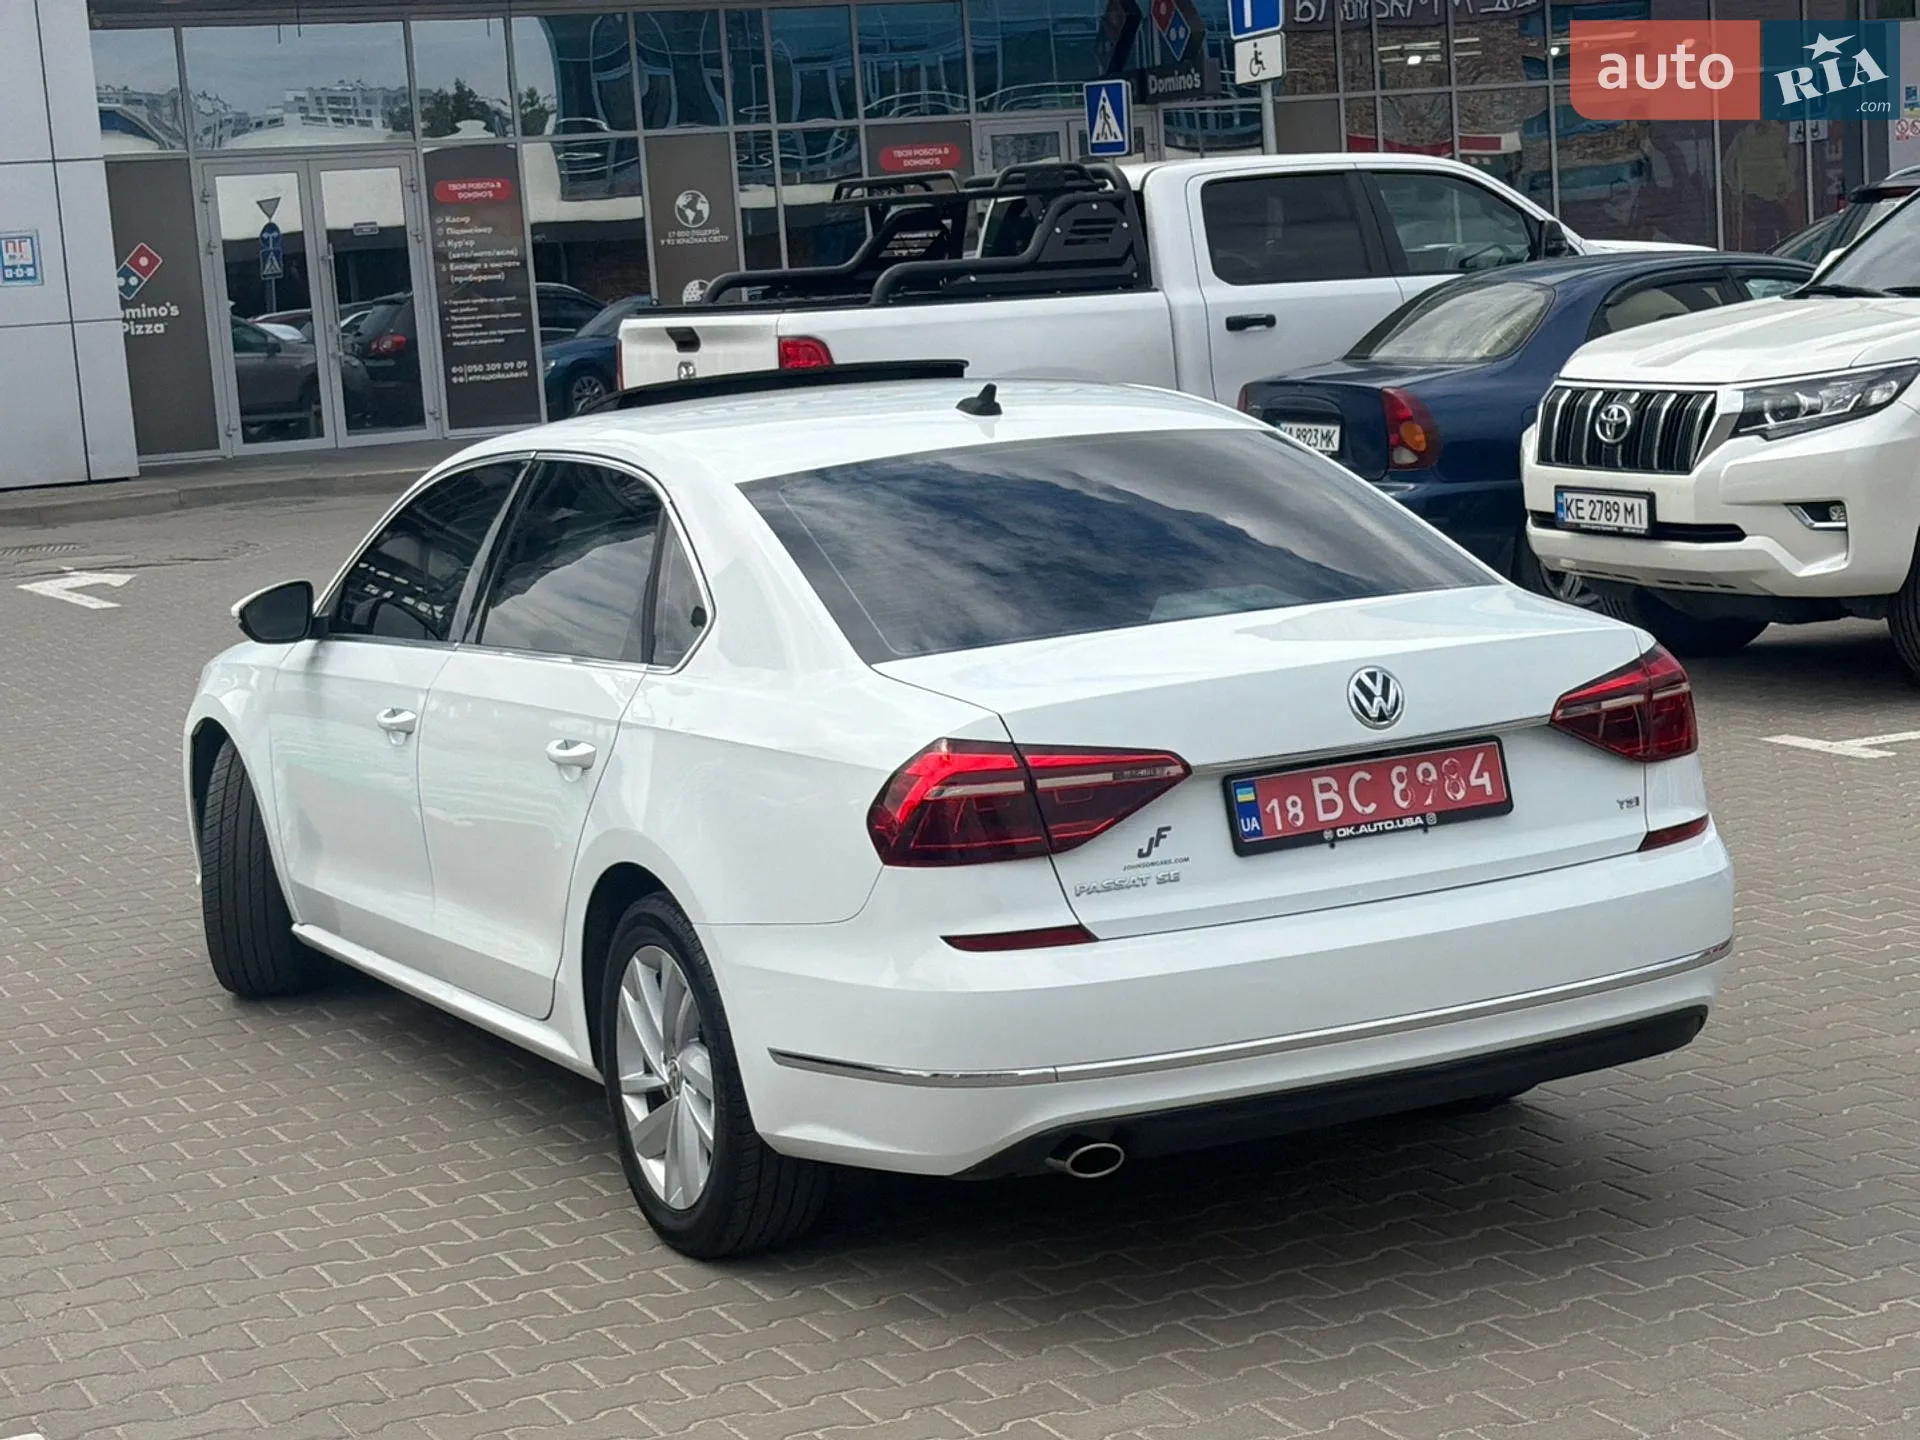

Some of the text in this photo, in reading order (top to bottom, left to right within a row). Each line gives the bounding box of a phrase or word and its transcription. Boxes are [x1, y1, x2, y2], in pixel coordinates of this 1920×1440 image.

[1147, 67, 1201, 95] Domino's
[444, 215, 471, 224] Касир
[121, 301, 180, 319] mino's
[1565, 497, 1643, 525] KE 2789 MI
[1240, 817, 1261, 834] UA
[1265, 795, 1305, 831] 18
[1311, 770, 1377, 822] BC
[1336, 816, 1424, 839] OK.AUTO.USA
[1074, 870, 1181, 897] PASSAT SE
